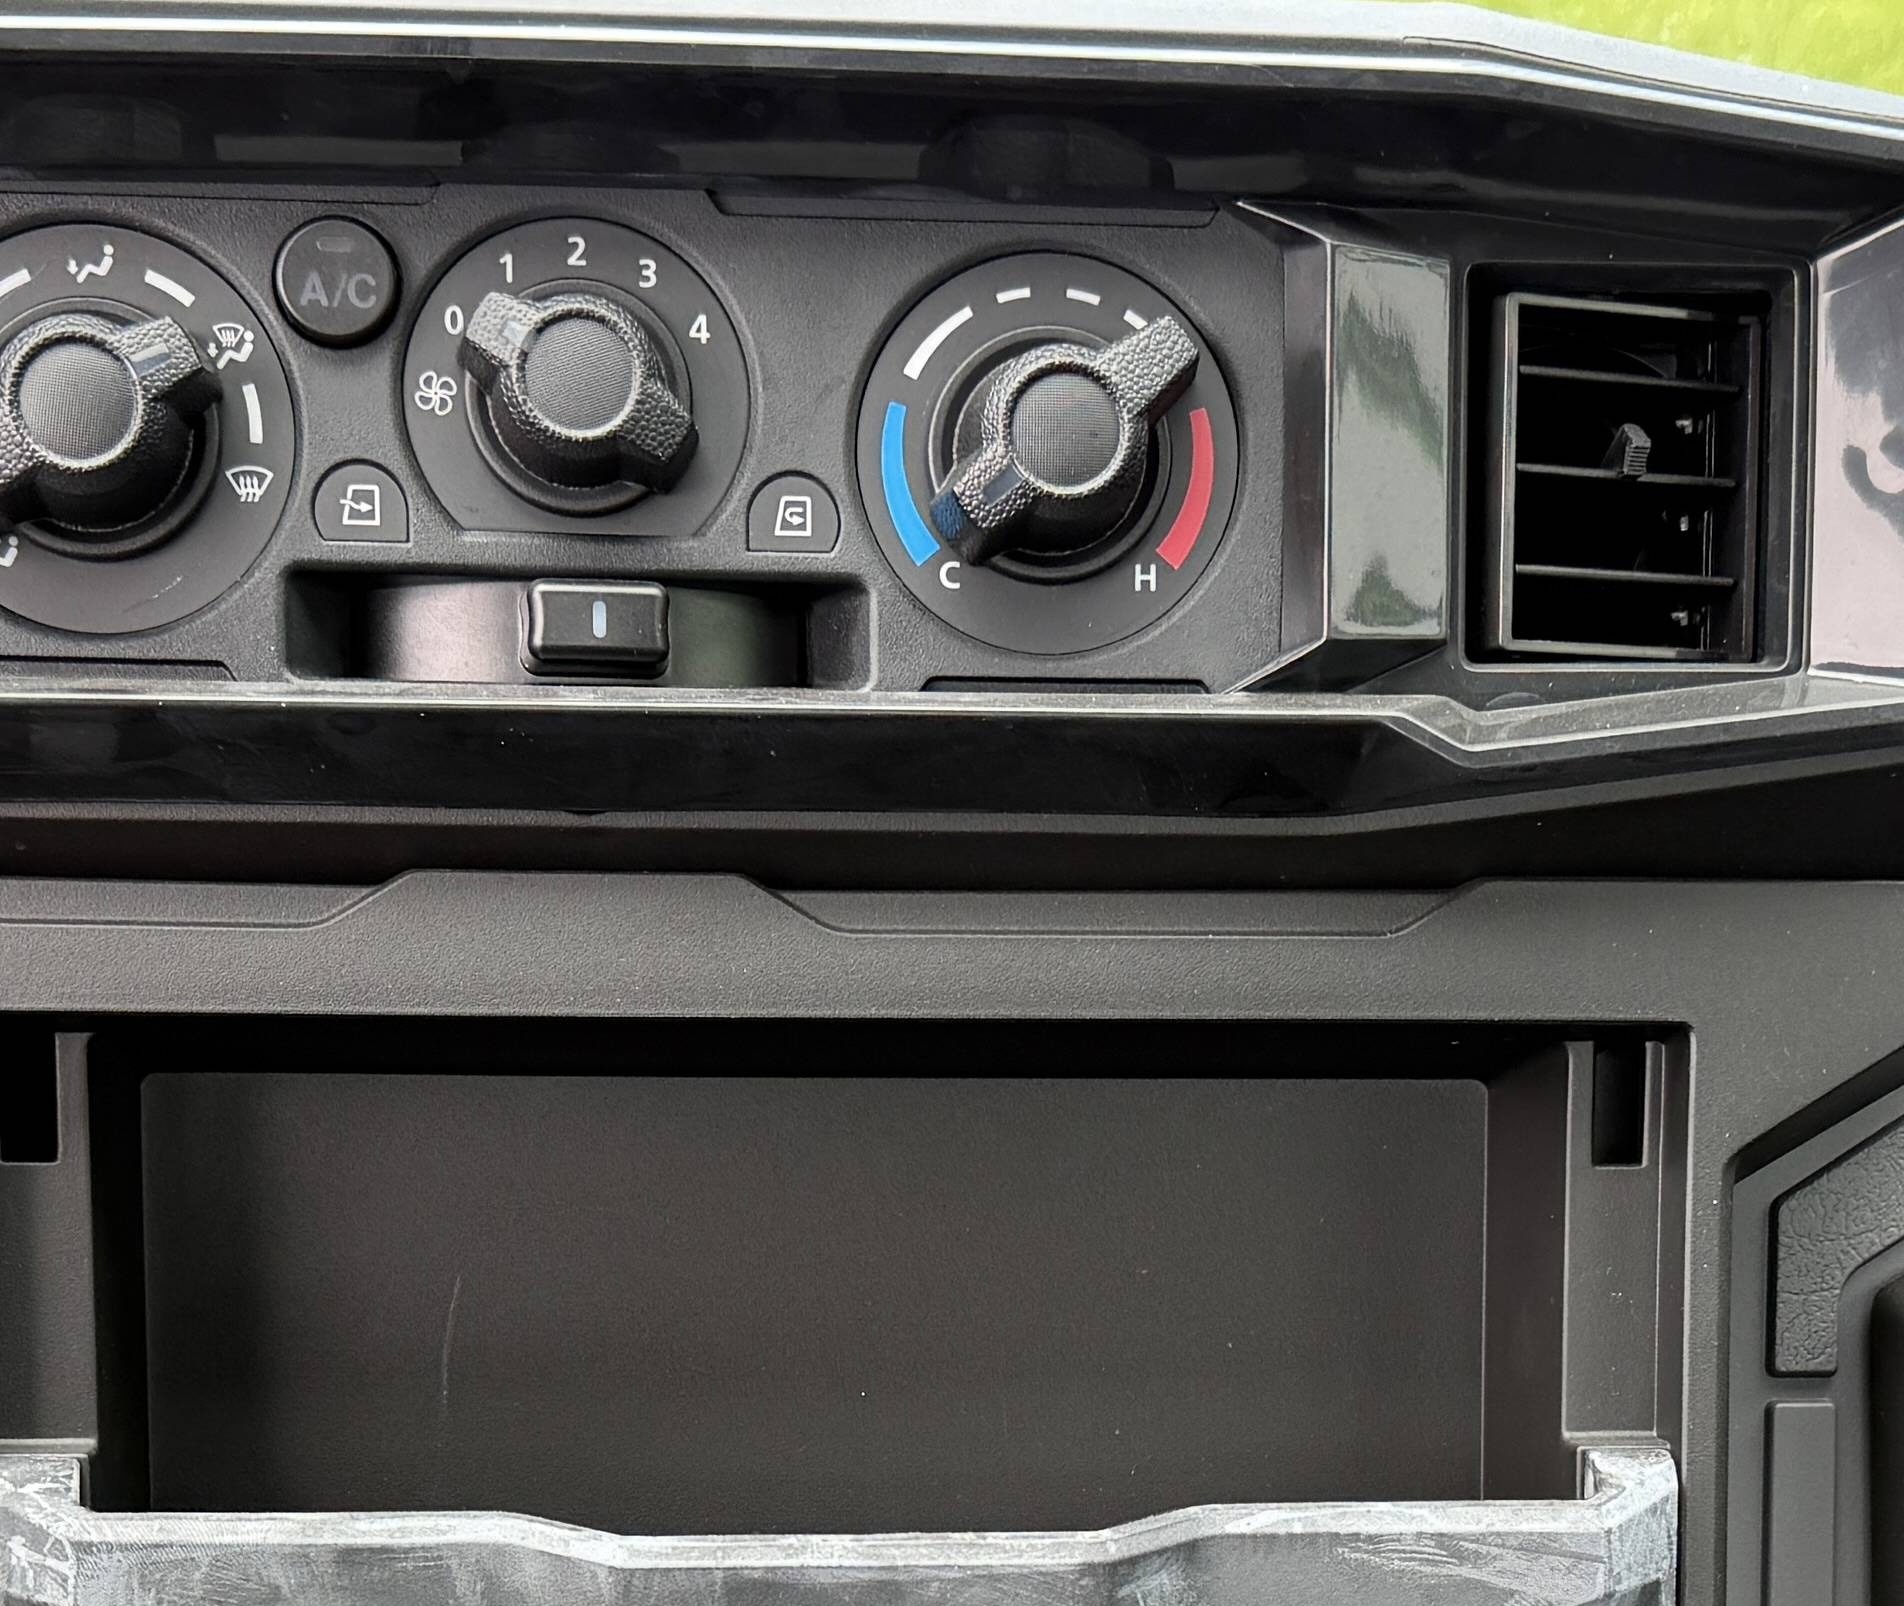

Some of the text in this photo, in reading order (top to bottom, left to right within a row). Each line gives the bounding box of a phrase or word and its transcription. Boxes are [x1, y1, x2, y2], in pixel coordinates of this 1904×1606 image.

[300, 273, 377, 309] A/C
[445, 237, 710, 343] 0 1 2 3 4
[940, 562, 960, 588] C
[1135, 564, 1156, 591] H
